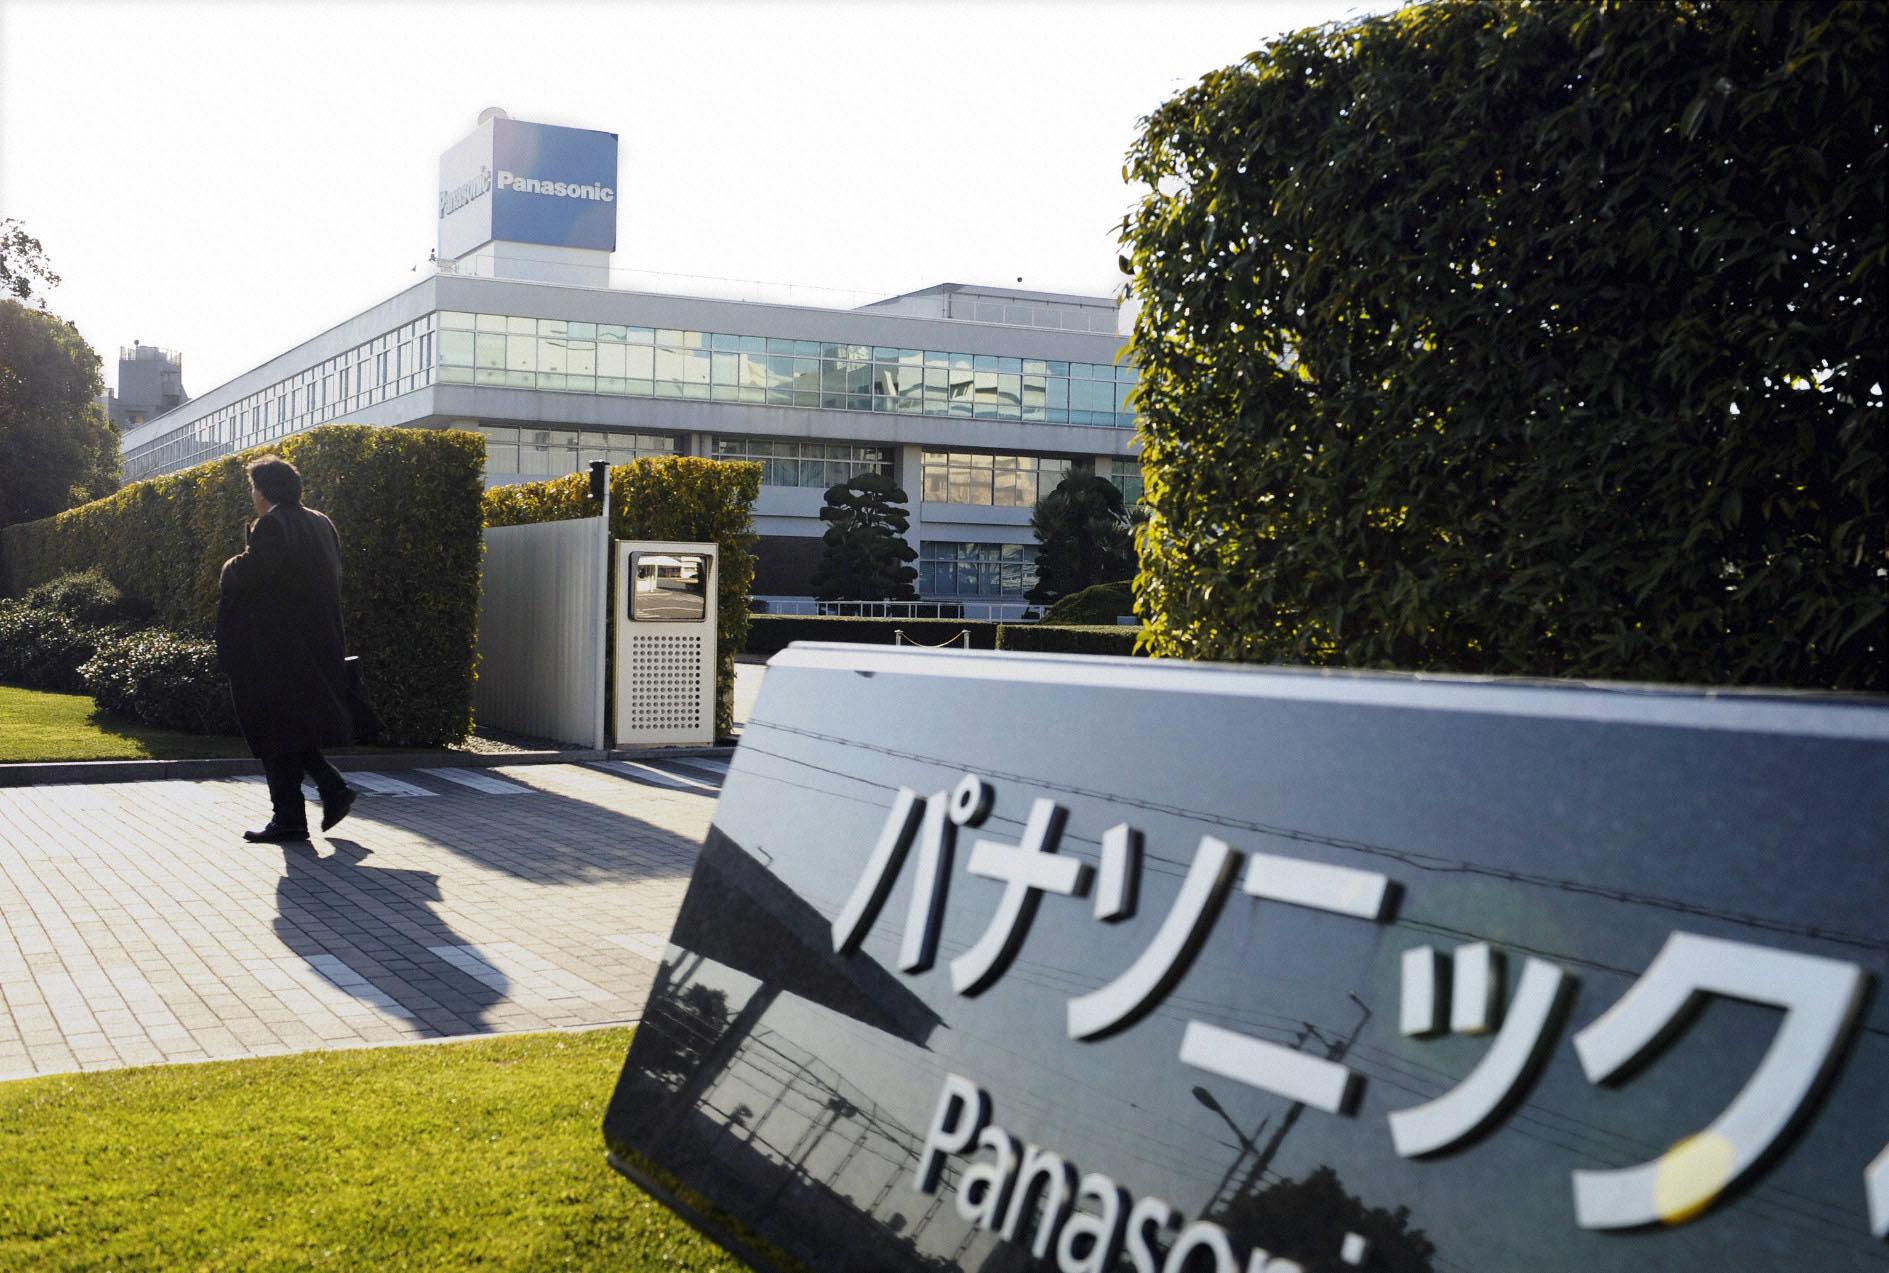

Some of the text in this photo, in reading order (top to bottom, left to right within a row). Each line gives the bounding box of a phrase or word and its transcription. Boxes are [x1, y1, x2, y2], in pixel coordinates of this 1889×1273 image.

[497, 169, 614, 202] Panasonic
[831, 774, 1889, 1237] パナソニック
[914, 1073, 1366, 1273] Panas
